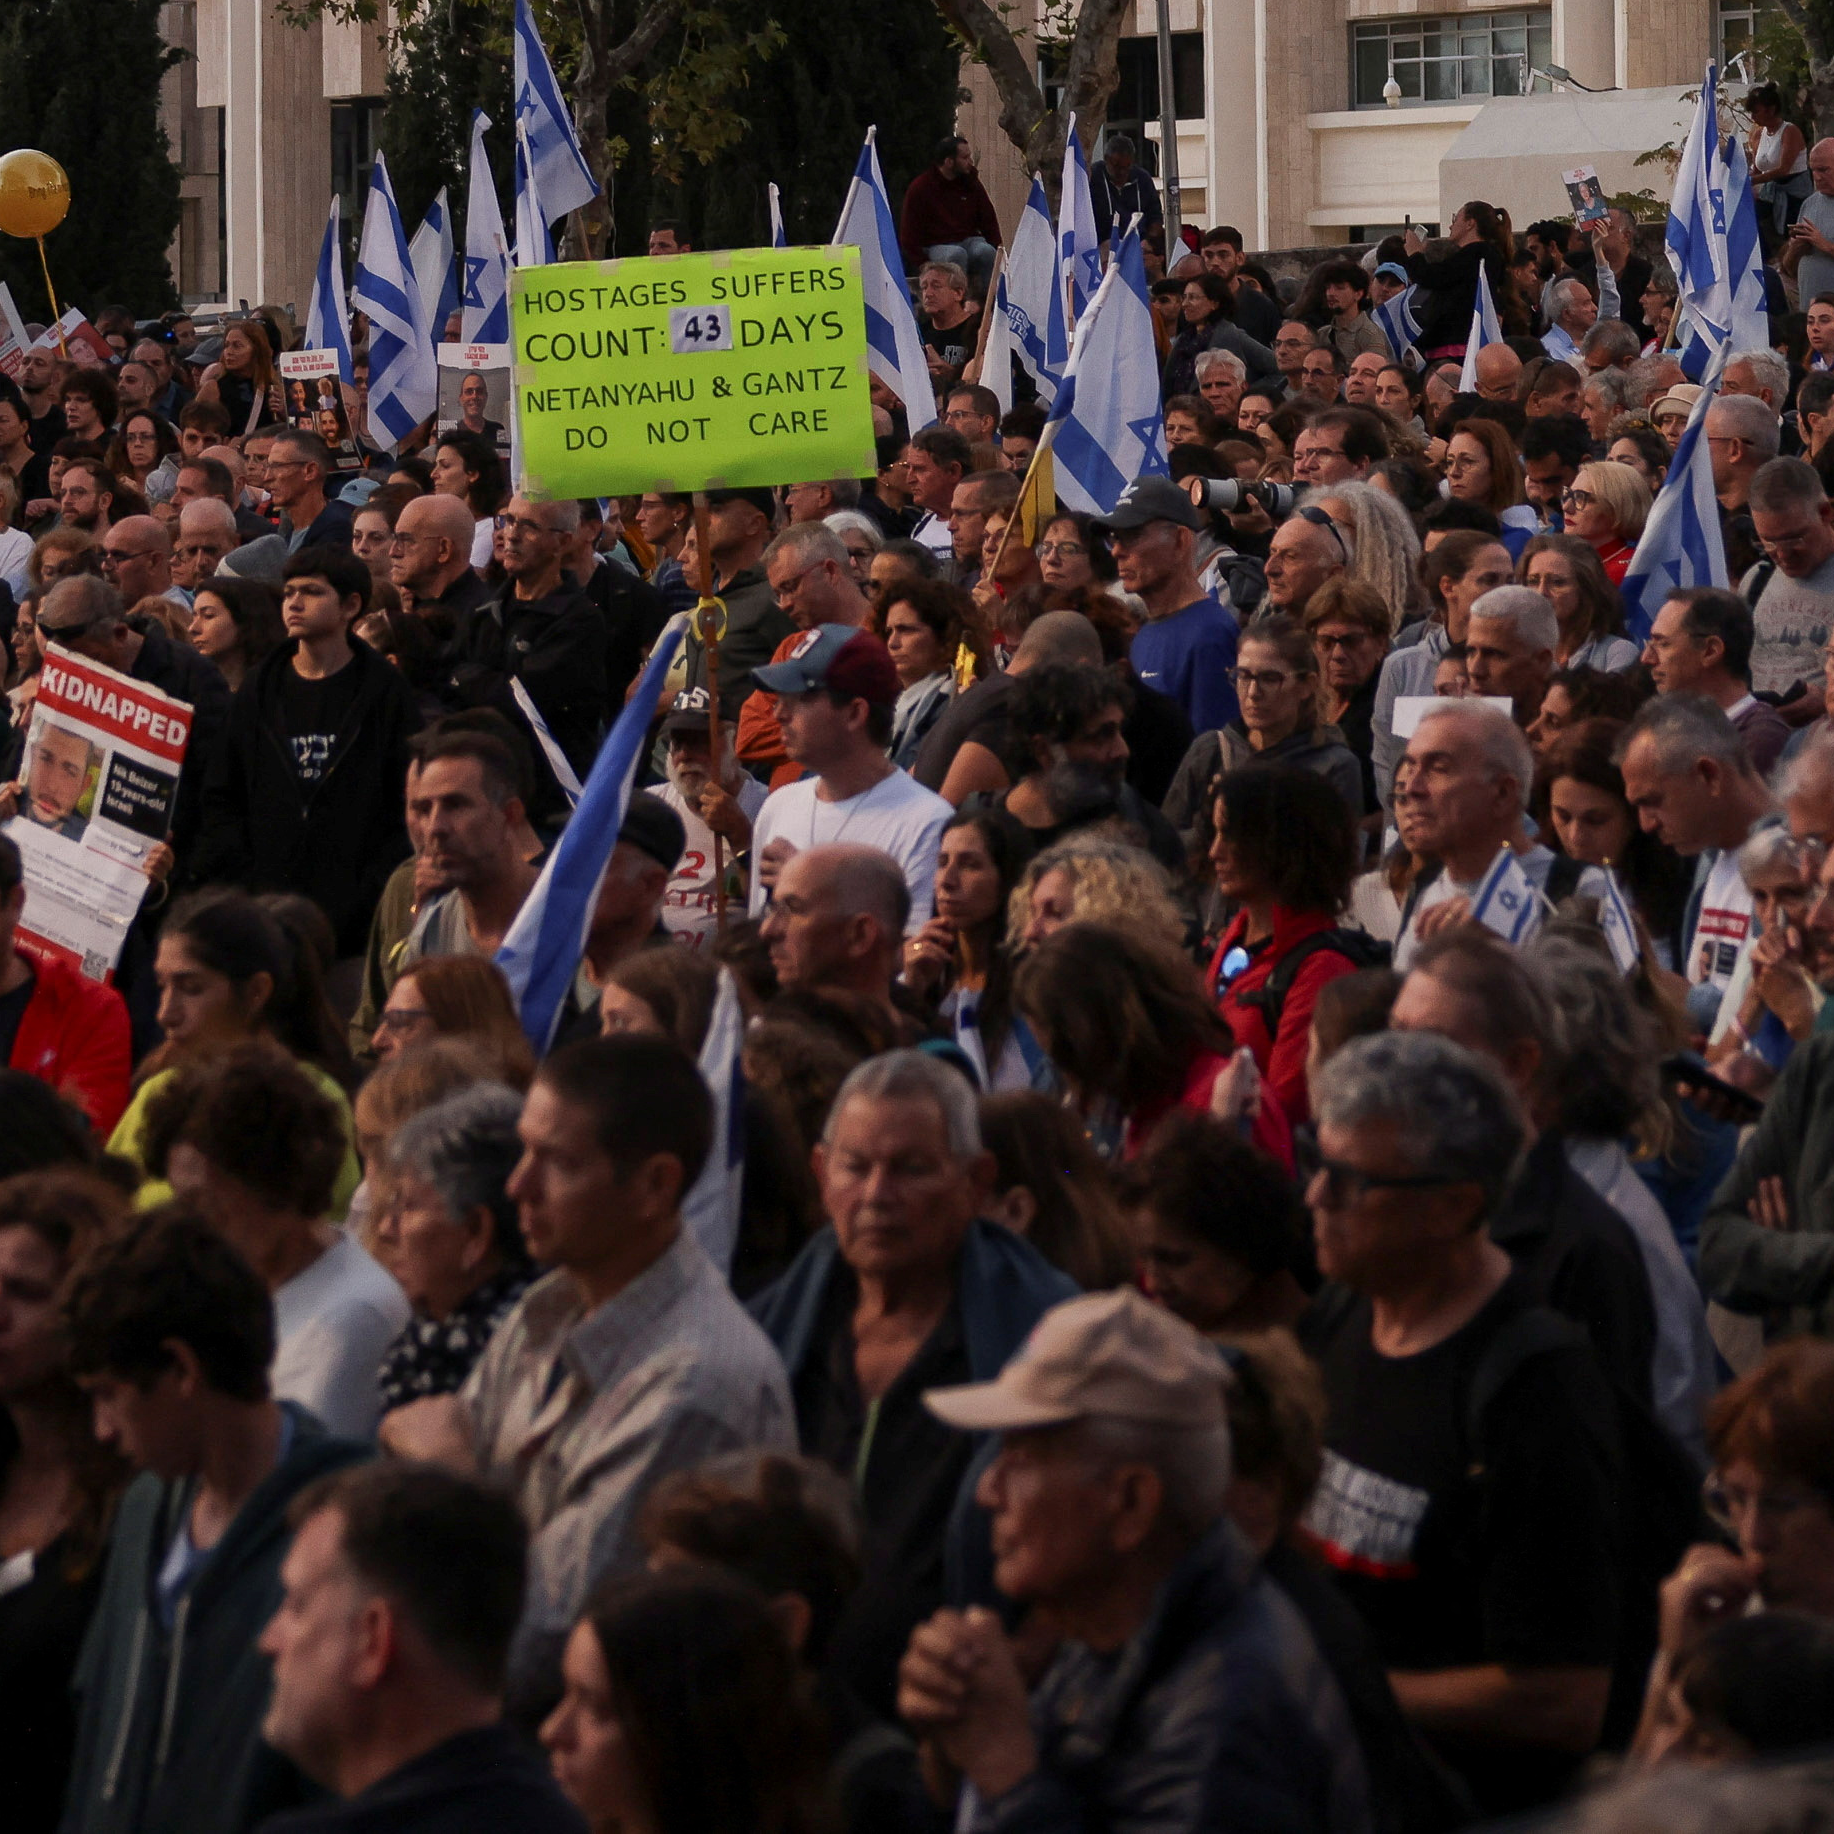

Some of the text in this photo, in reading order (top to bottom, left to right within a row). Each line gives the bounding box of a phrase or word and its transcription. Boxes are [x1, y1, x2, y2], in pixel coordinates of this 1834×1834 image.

[524, 266, 845, 315] HOSTAGES SUFFERS
[525, 310, 844, 363] COUNT: 43 DAYS
[527, 365, 848, 413] NETANYAHU & GANTZ
[565, 408, 829, 451] DO NOT CARE
[40, 664, 187, 747] KIDNAPPED
